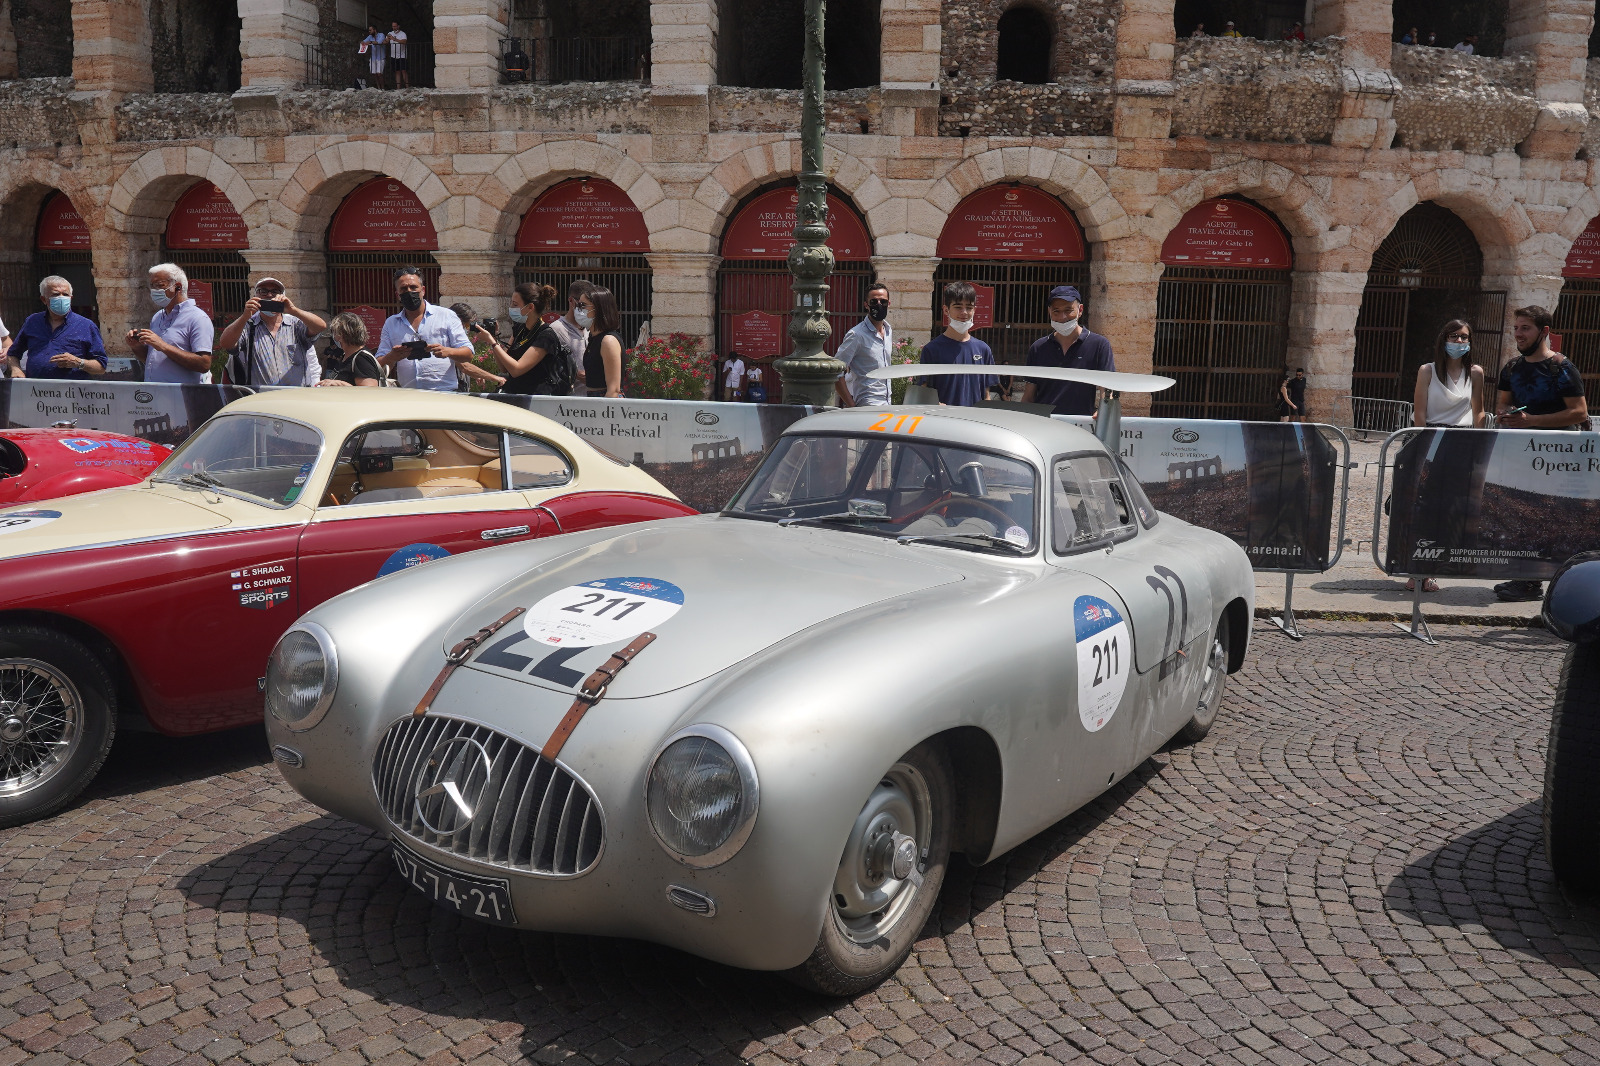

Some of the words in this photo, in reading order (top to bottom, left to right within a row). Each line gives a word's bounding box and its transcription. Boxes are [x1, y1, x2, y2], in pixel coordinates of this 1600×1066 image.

[757, 212, 783, 220] AREA
[964, 214, 1011, 222] GRADINATA
[1012, 215, 1057, 223] NUMERATA
[977, 230, 1005, 238] Entrata
[1187, 227, 1217, 235] TRAVEL
[1218, 228, 1254, 236] AGENCIES
[1186, 238, 1218, 246] Cancello
[30, 385, 61, 399] Arena
[64, 386, 75, 399] di
[77, 387, 115, 400] Verona
[36, 400, 68, 416] Opera
[71, 402, 111, 416] Festival
[555, 403, 597, 418] Arena
[601, 406, 615, 419] di
[620, 406, 668, 421] Verona
[867, 413, 925, 434] 211
[610, 423, 662, 438] Festival
[1524, 438, 1574, 453] Arena
[1579, 439, 1595, 454] di
[1531, 456, 1581, 475] Opera
[1411, 548, 1445, 559] AMT
[1449, 548, 1489, 556] SUPPORTER
[1498, 550, 1540, 558] FONDAZIONE
[1481, 557, 1509, 565] VERONA
[242, 569, 251, 577] E.
[252, 565, 285, 576] SHRAGA
[253, 575, 292, 588] SCHWARZ
[240, 591, 289, 605] SPORTS
[560, 592, 646, 621] 211
[1092, 635, 1119, 688] 211
